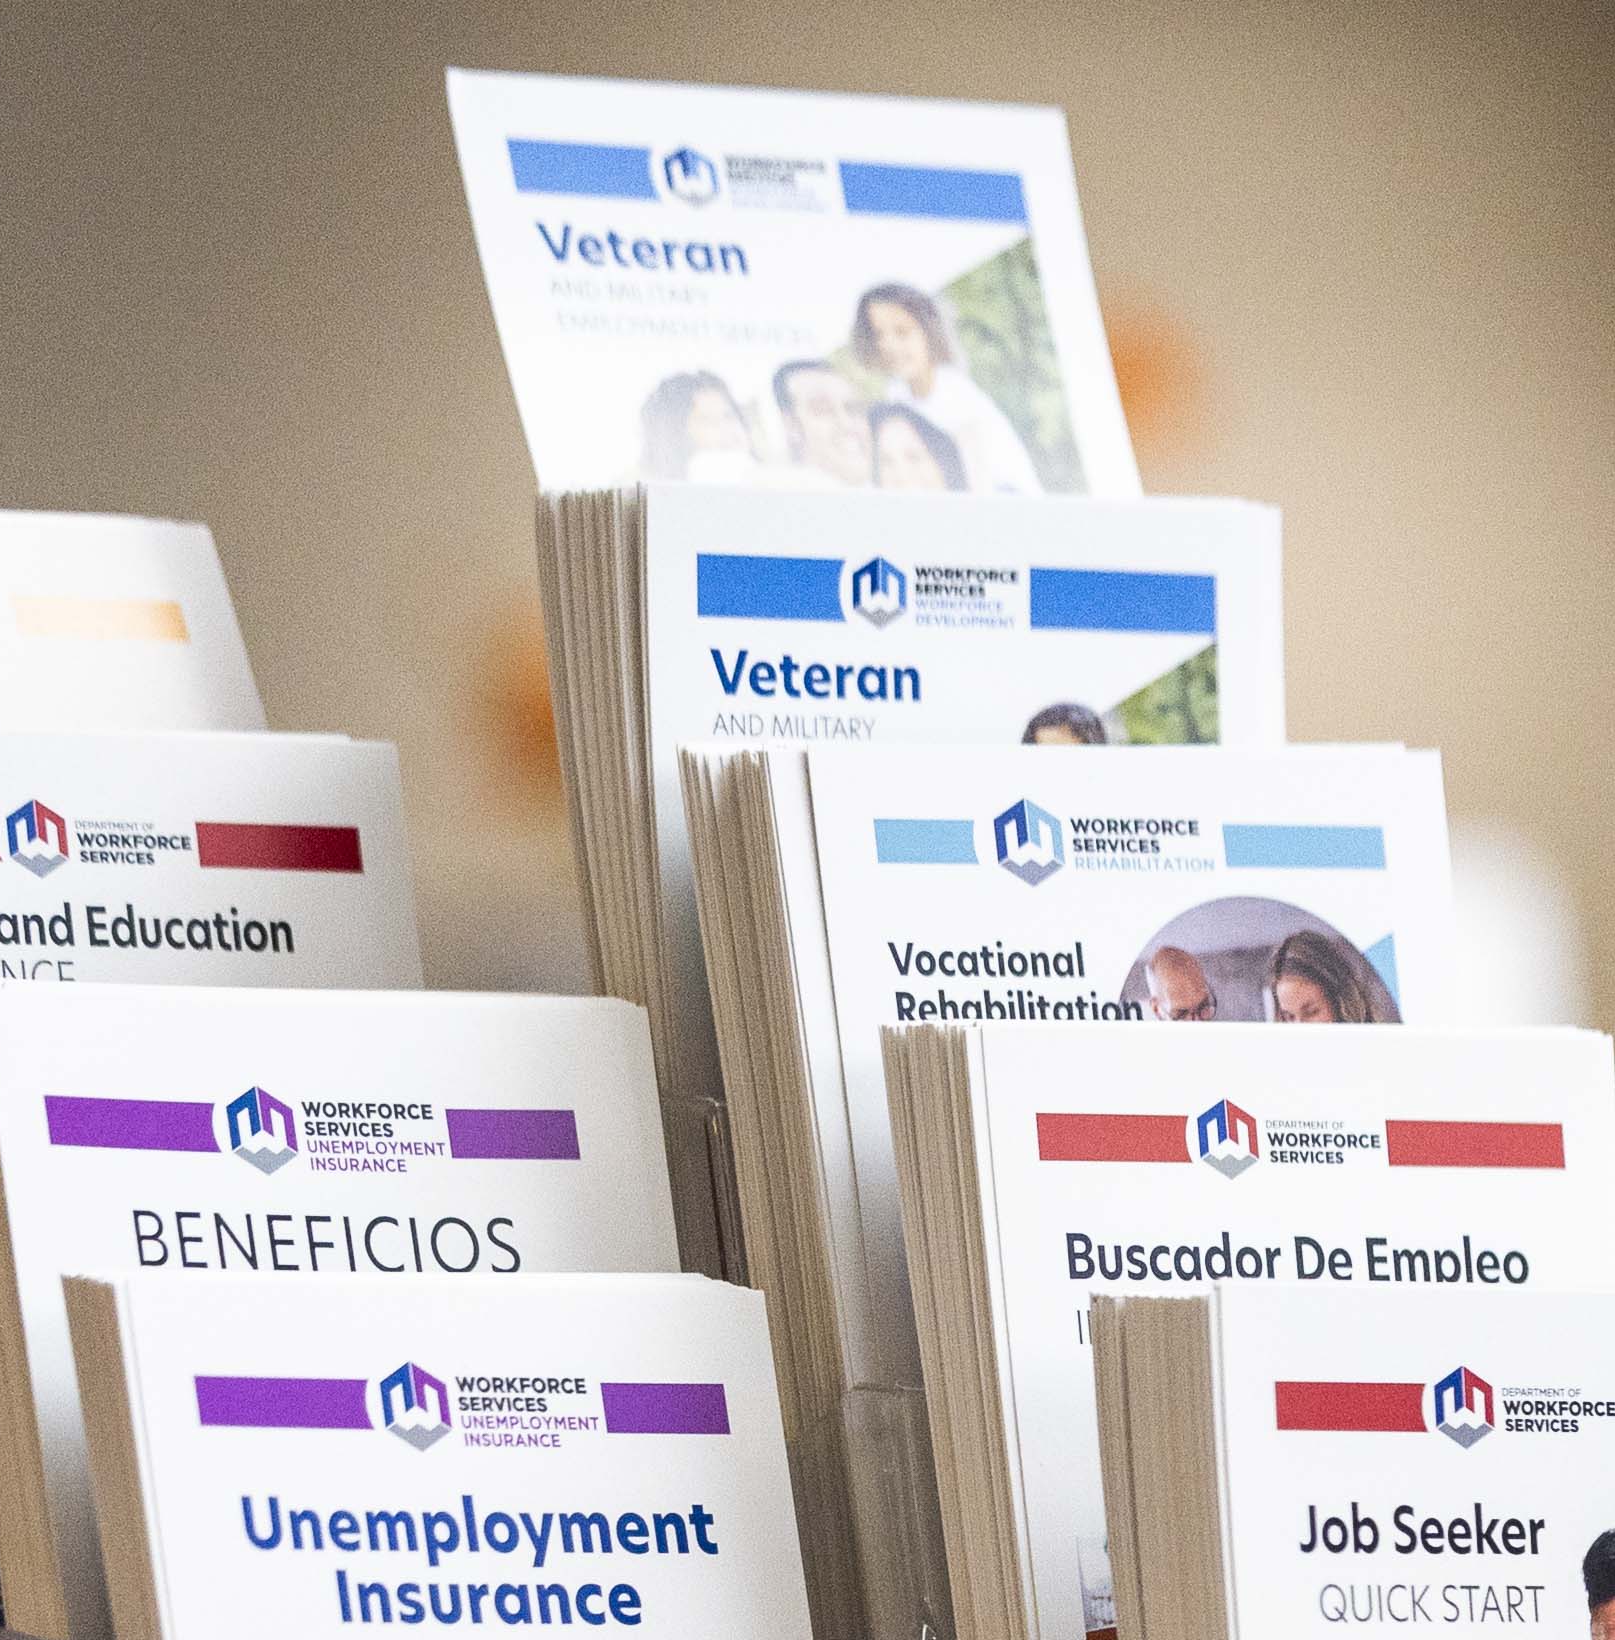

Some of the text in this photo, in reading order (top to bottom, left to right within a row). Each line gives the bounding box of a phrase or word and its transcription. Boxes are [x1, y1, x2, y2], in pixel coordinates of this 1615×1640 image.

[535, 221, 749, 275] Veteran
[914, 566, 1018, 584] WORKFORCE
[710, 648, 921, 702] Veteran
[713, 713, 876, 741] AND MILITARY
[1070, 817, 1200, 836] WORKFORCE
[76, 832, 192, 852] WORKFORCE
[1072, 837, 1161, 854] SERVICES
[80, 849, 155, 866] SERVICES
[1074, 856, 1215, 873] REHABILITATION
[86, 904, 295, 953] Education
[888, 941, 1086, 979] Vocational
[895, 989, 1144, 1021] Rehabilitation
[301, 1101, 434, 1121] WORKFORCE
[304, 1121, 394, 1138] SERVICES
[306, 1140, 446, 1157] UNEMPLOYMENT
[1267, 1131, 1381, 1150] WORKFORCE
[310, 1157, 407, 1173] INSURANCE
[1269, 1149, 1345, 1165] SERVICES
[133, 1210, 522, 1273] BENEFICIOS
[1065, 1231, 1281, 1282] Buscador
[1294, 1235, 1353, 1281] De
[455, 1376, 588, 1395] WORKFORCE
[1501, 1386, 1565, 1398] DEPARTMENT
[458, 1395, 549, 1413] SERVICES
[460, 1413, 599, 1431] UNEMPLOYMENT
[1505, 1417, 1580, 1434] SERVICES
[464, 1431, 562, 1448] INSURANCE
[241, 1494, 720, 1568] Unemployment
[1300, 1501, 1546, 1556] Job Seeker
[335, 1569, 643, 1626] Insurance
[1319, 1582, 1546, 1624] QUICK START
